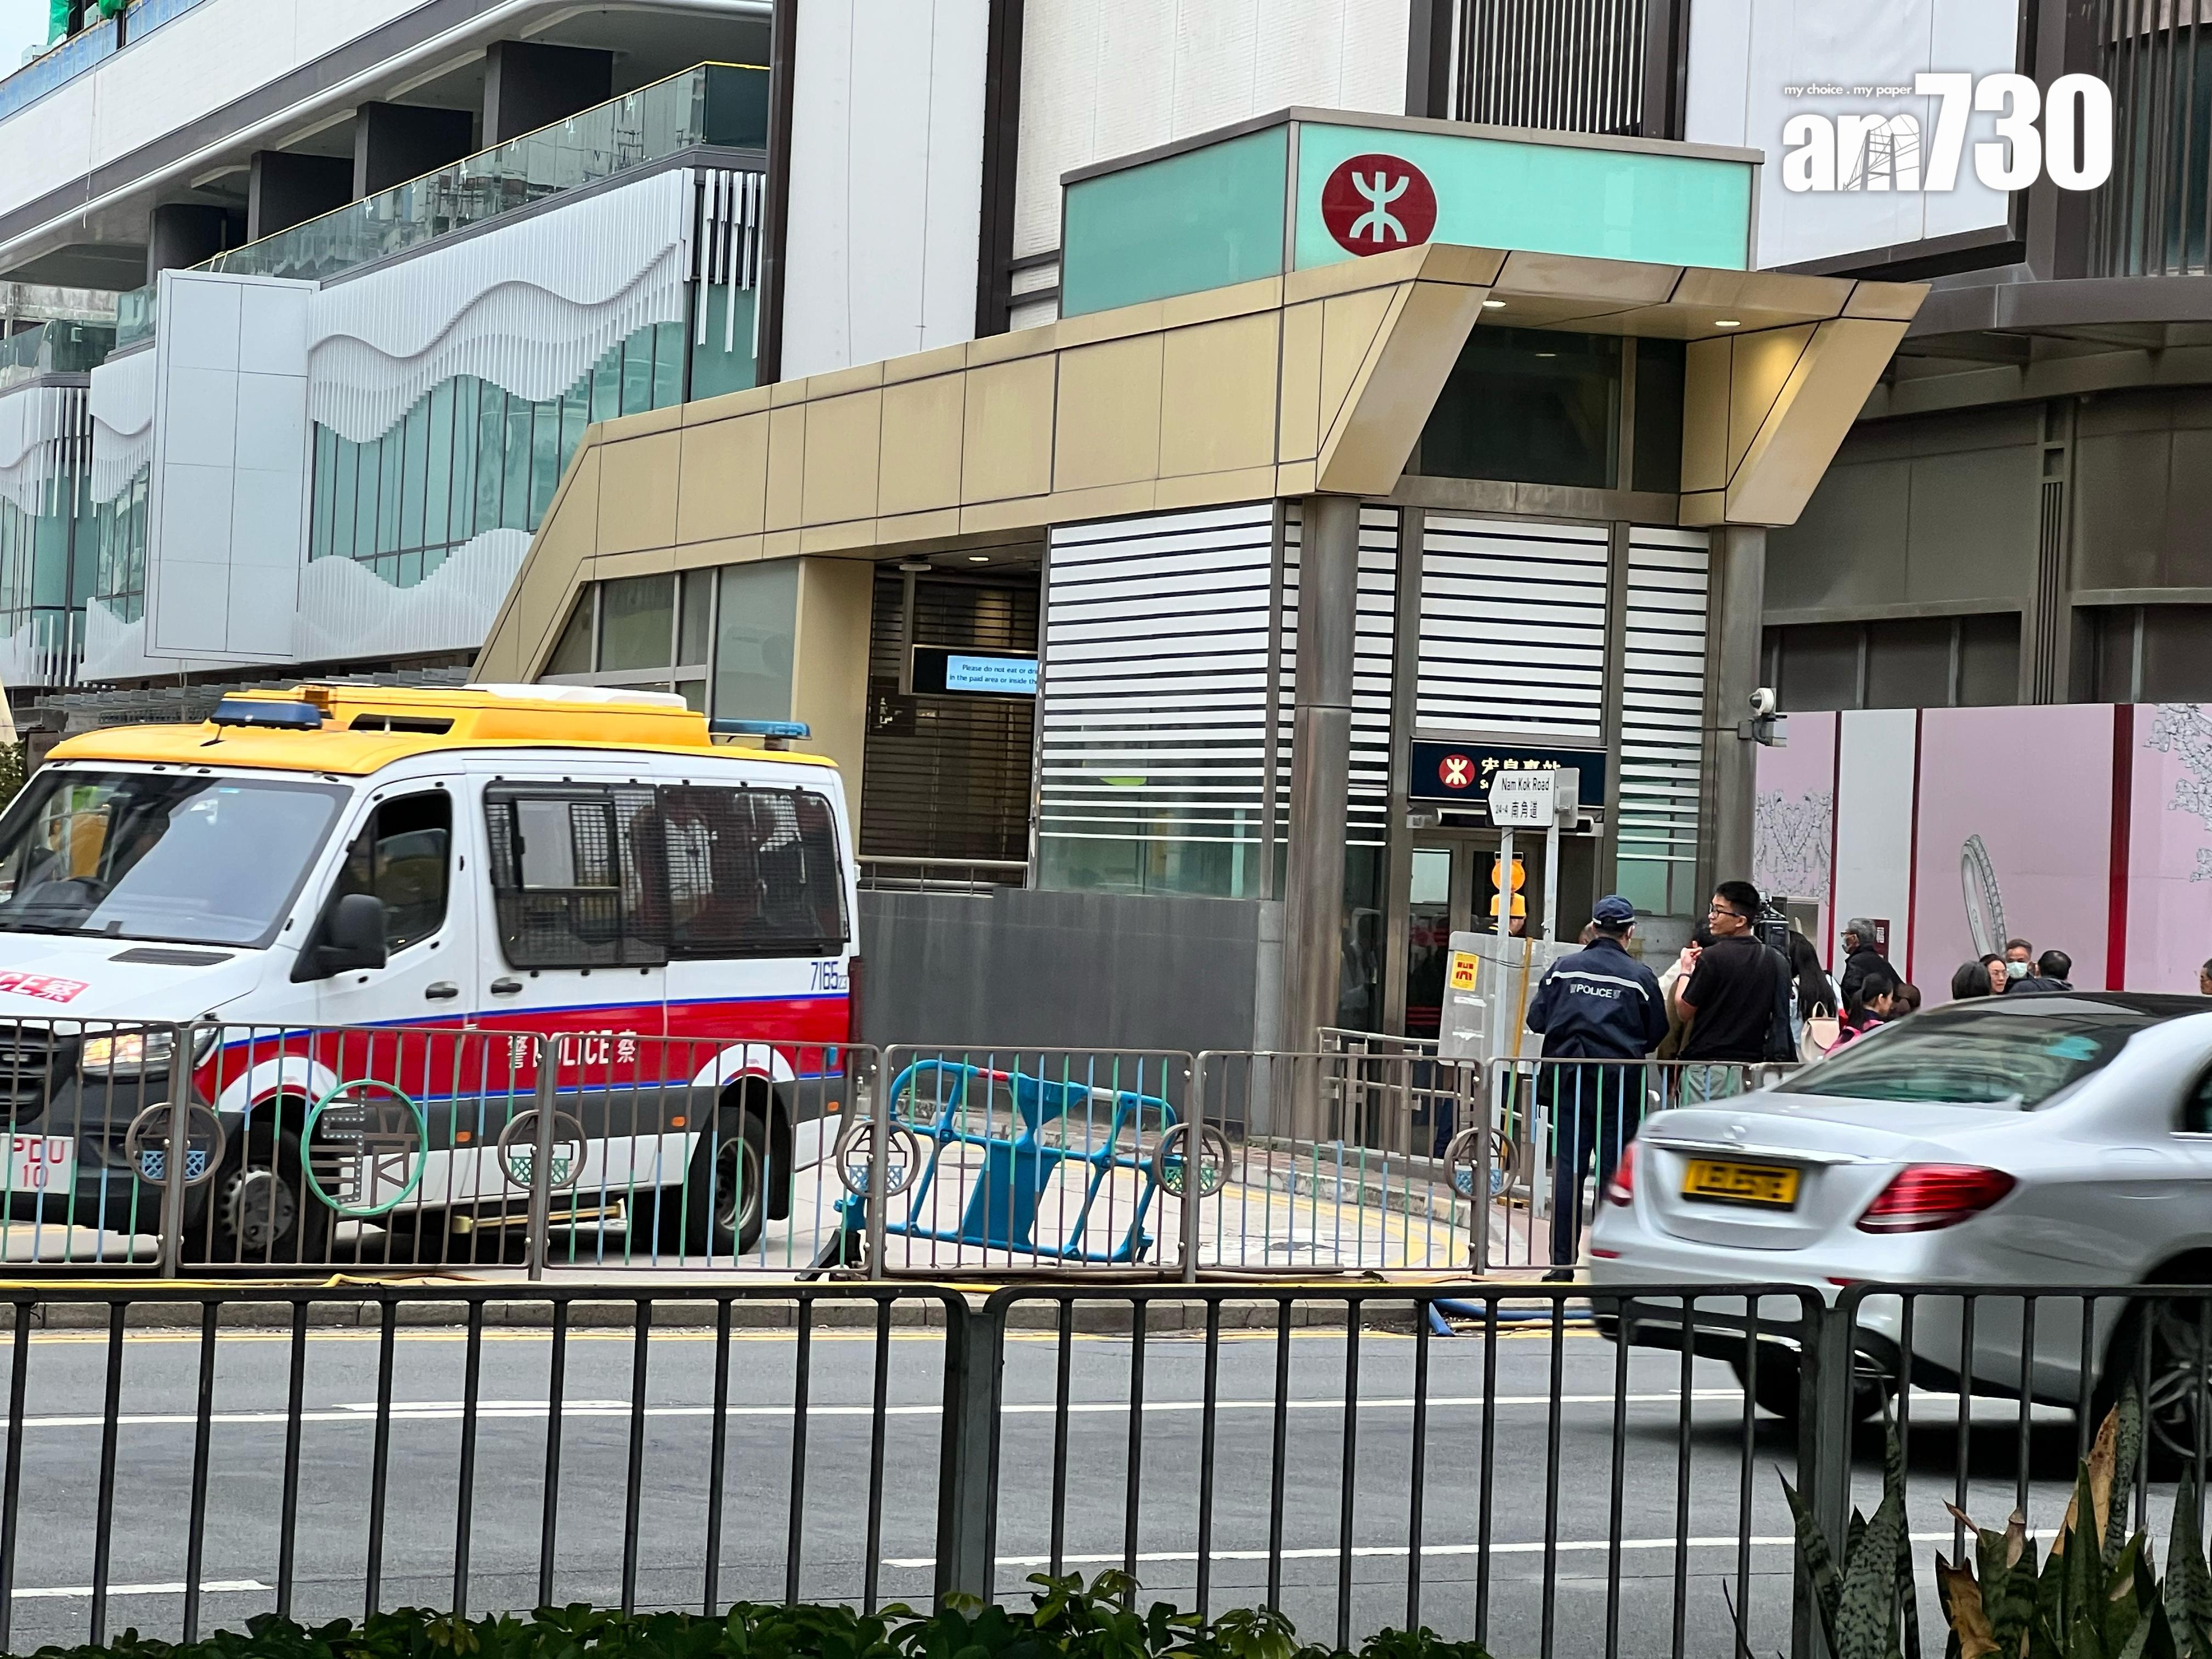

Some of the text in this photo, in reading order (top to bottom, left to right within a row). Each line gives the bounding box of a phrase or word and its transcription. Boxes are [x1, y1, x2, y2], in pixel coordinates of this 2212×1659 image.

[1502, 777, 1550, 791] Nam Kok Road
[1511, 800, 1537, 819] 南角道
[811, 961, 838, 991] 7165
